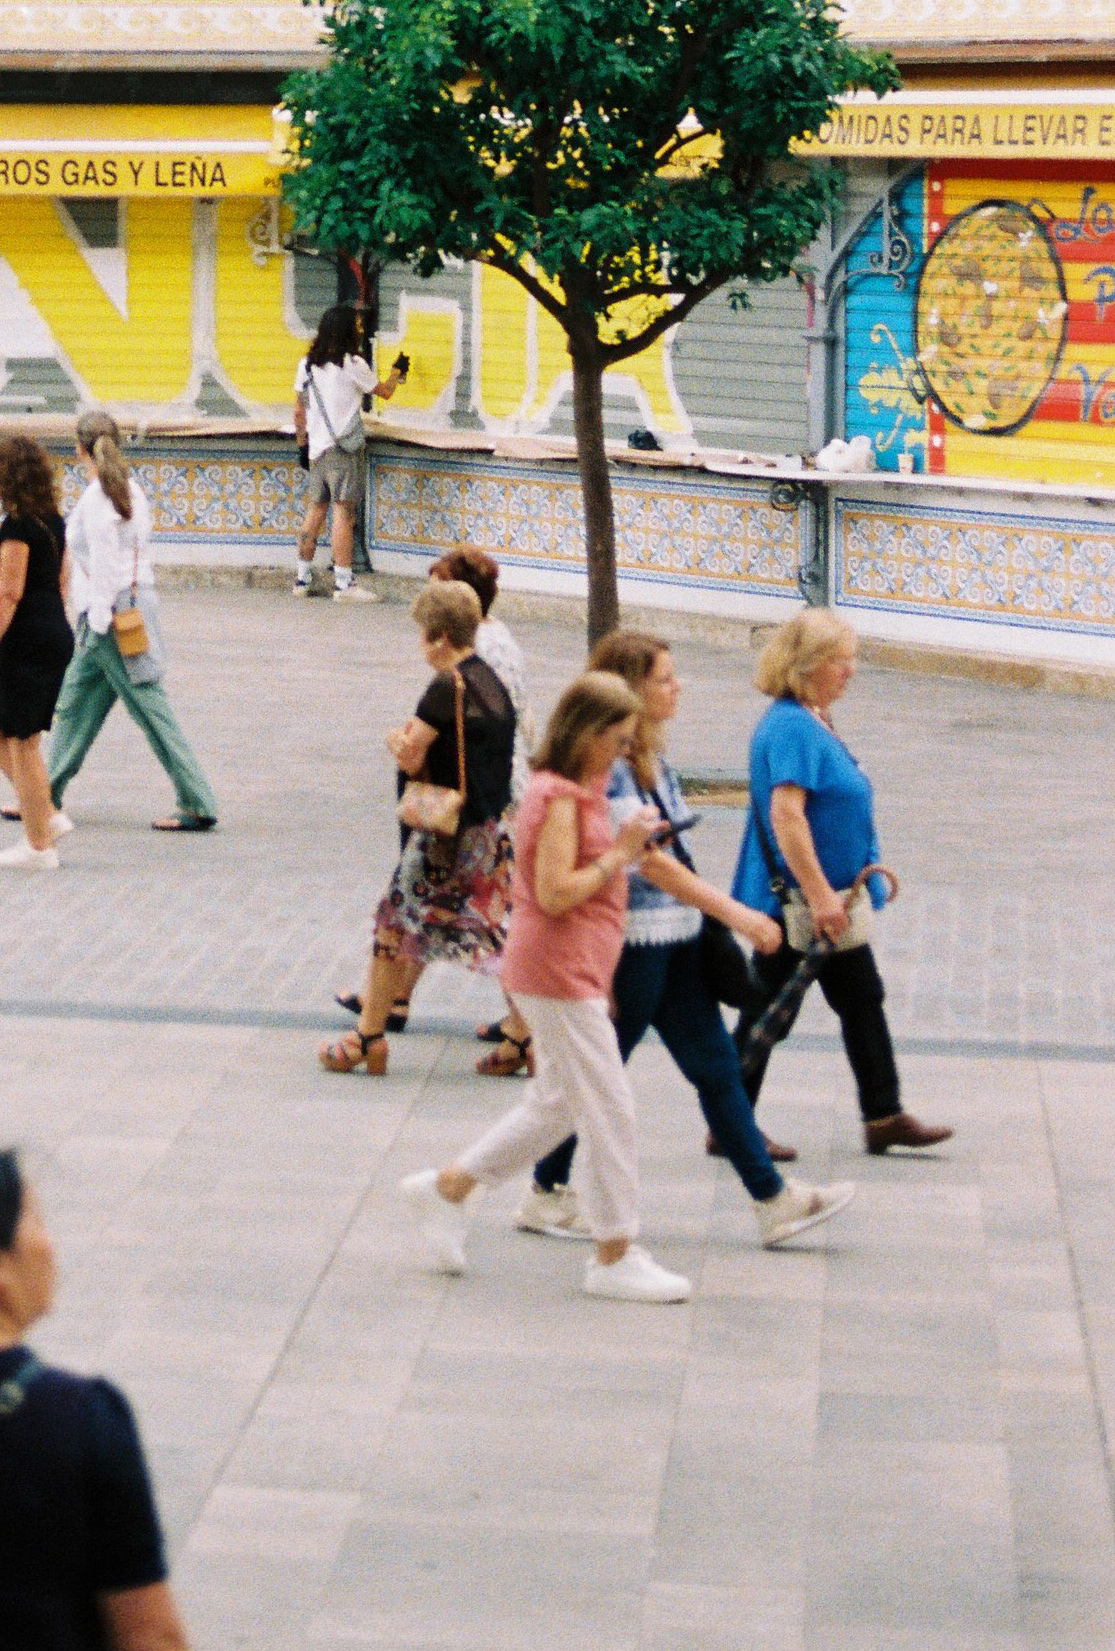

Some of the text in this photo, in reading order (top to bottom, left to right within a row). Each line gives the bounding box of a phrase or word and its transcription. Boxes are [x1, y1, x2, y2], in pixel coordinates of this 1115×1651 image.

[801, 113, 910, 147] OMIDAS
[918, 113, 984, 147] PARA
[992, 114, 1089, 146] LLEVAR
[60, 159, 118, 186] GAS
[128, 161, 144, 187] Y
[154, 156, 227, 188] LEÑA
